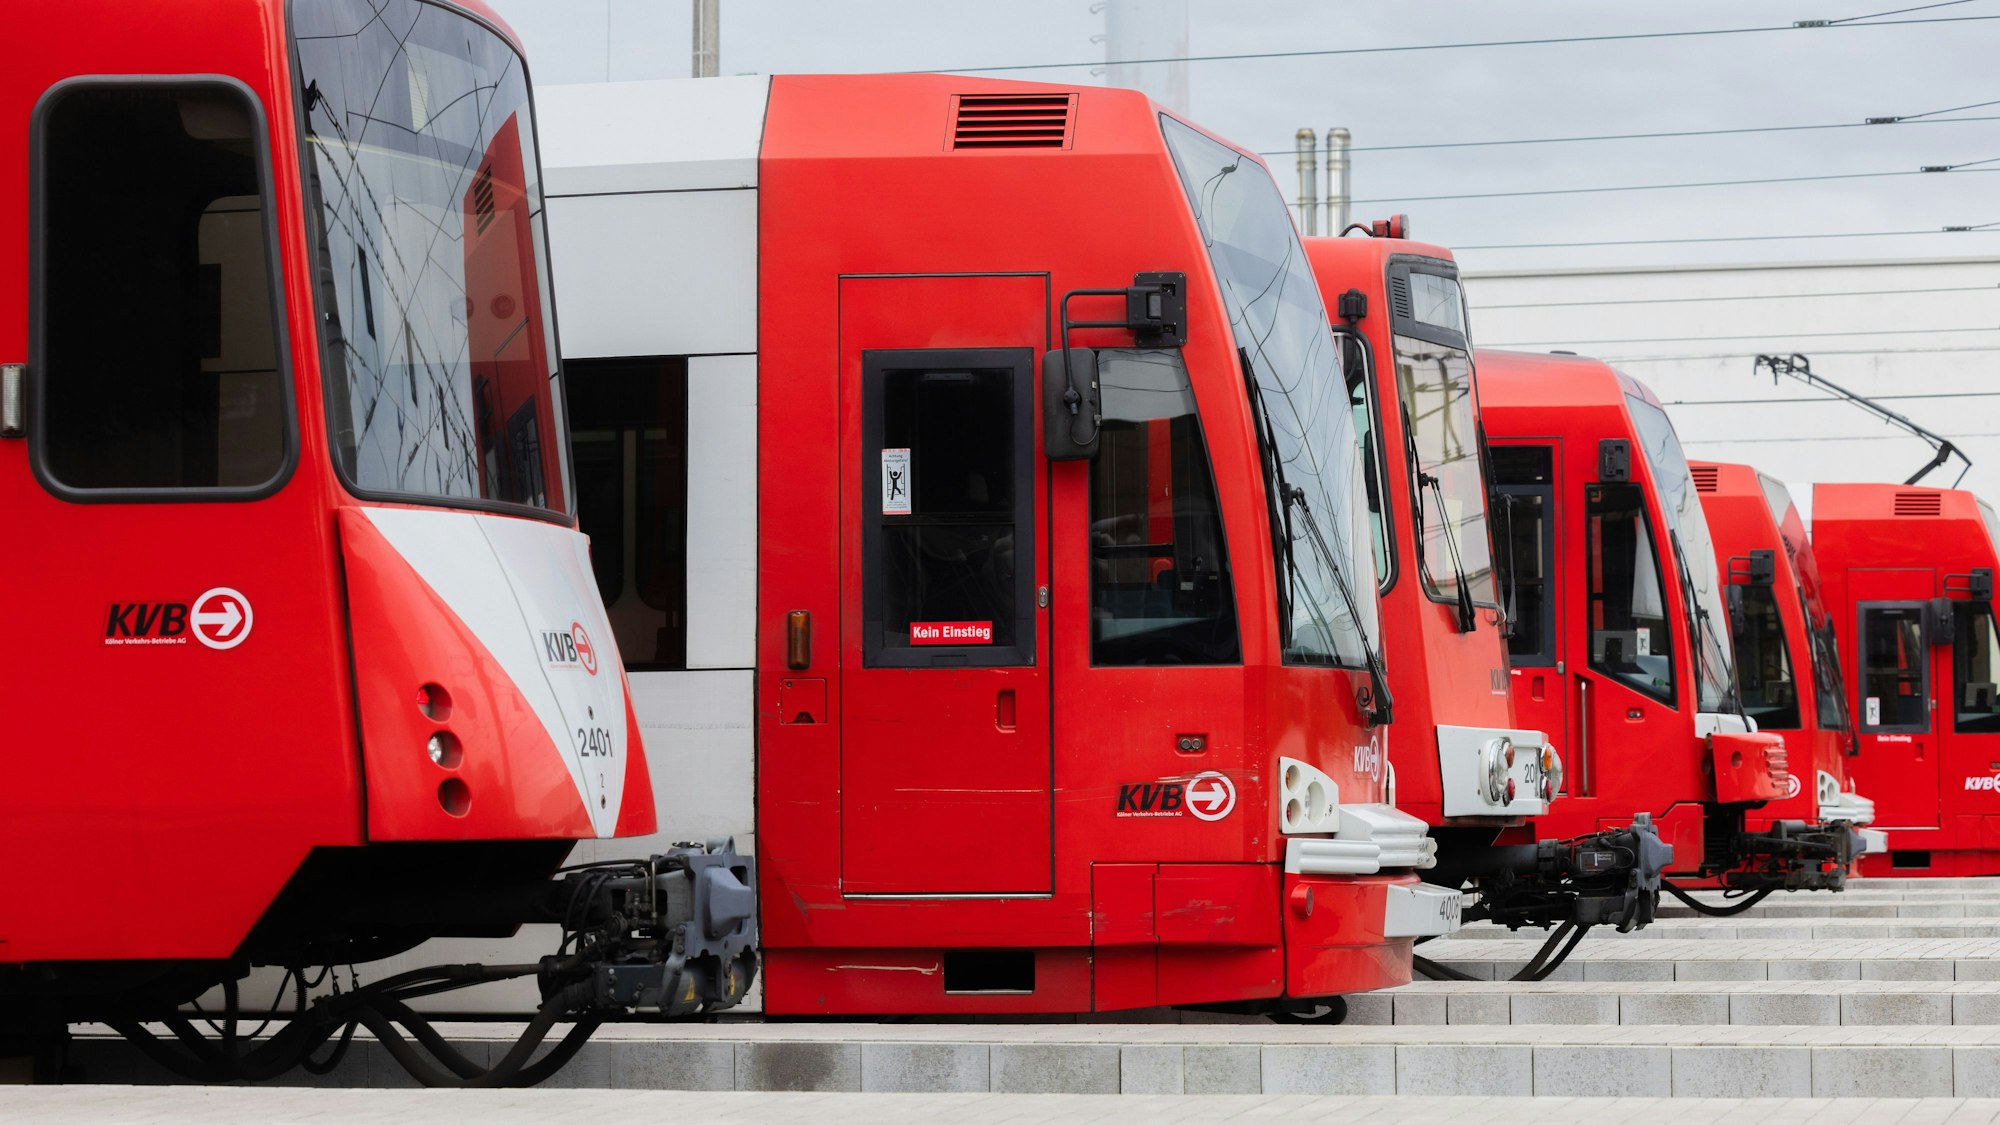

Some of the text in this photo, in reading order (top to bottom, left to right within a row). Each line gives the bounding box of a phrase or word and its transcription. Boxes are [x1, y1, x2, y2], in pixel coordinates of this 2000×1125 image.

[105, 603, 188, 636] KVB
[913, 626, 990, 640] Kein Einstieg
[542, 632, 577, 662] KVB
[578, 727, 613, 758] 2401
[1353, 745, 1370, 772] KVB
[1964, 776, 1994, 790] KVB
[1117, 784, 1183, 810] KVB
